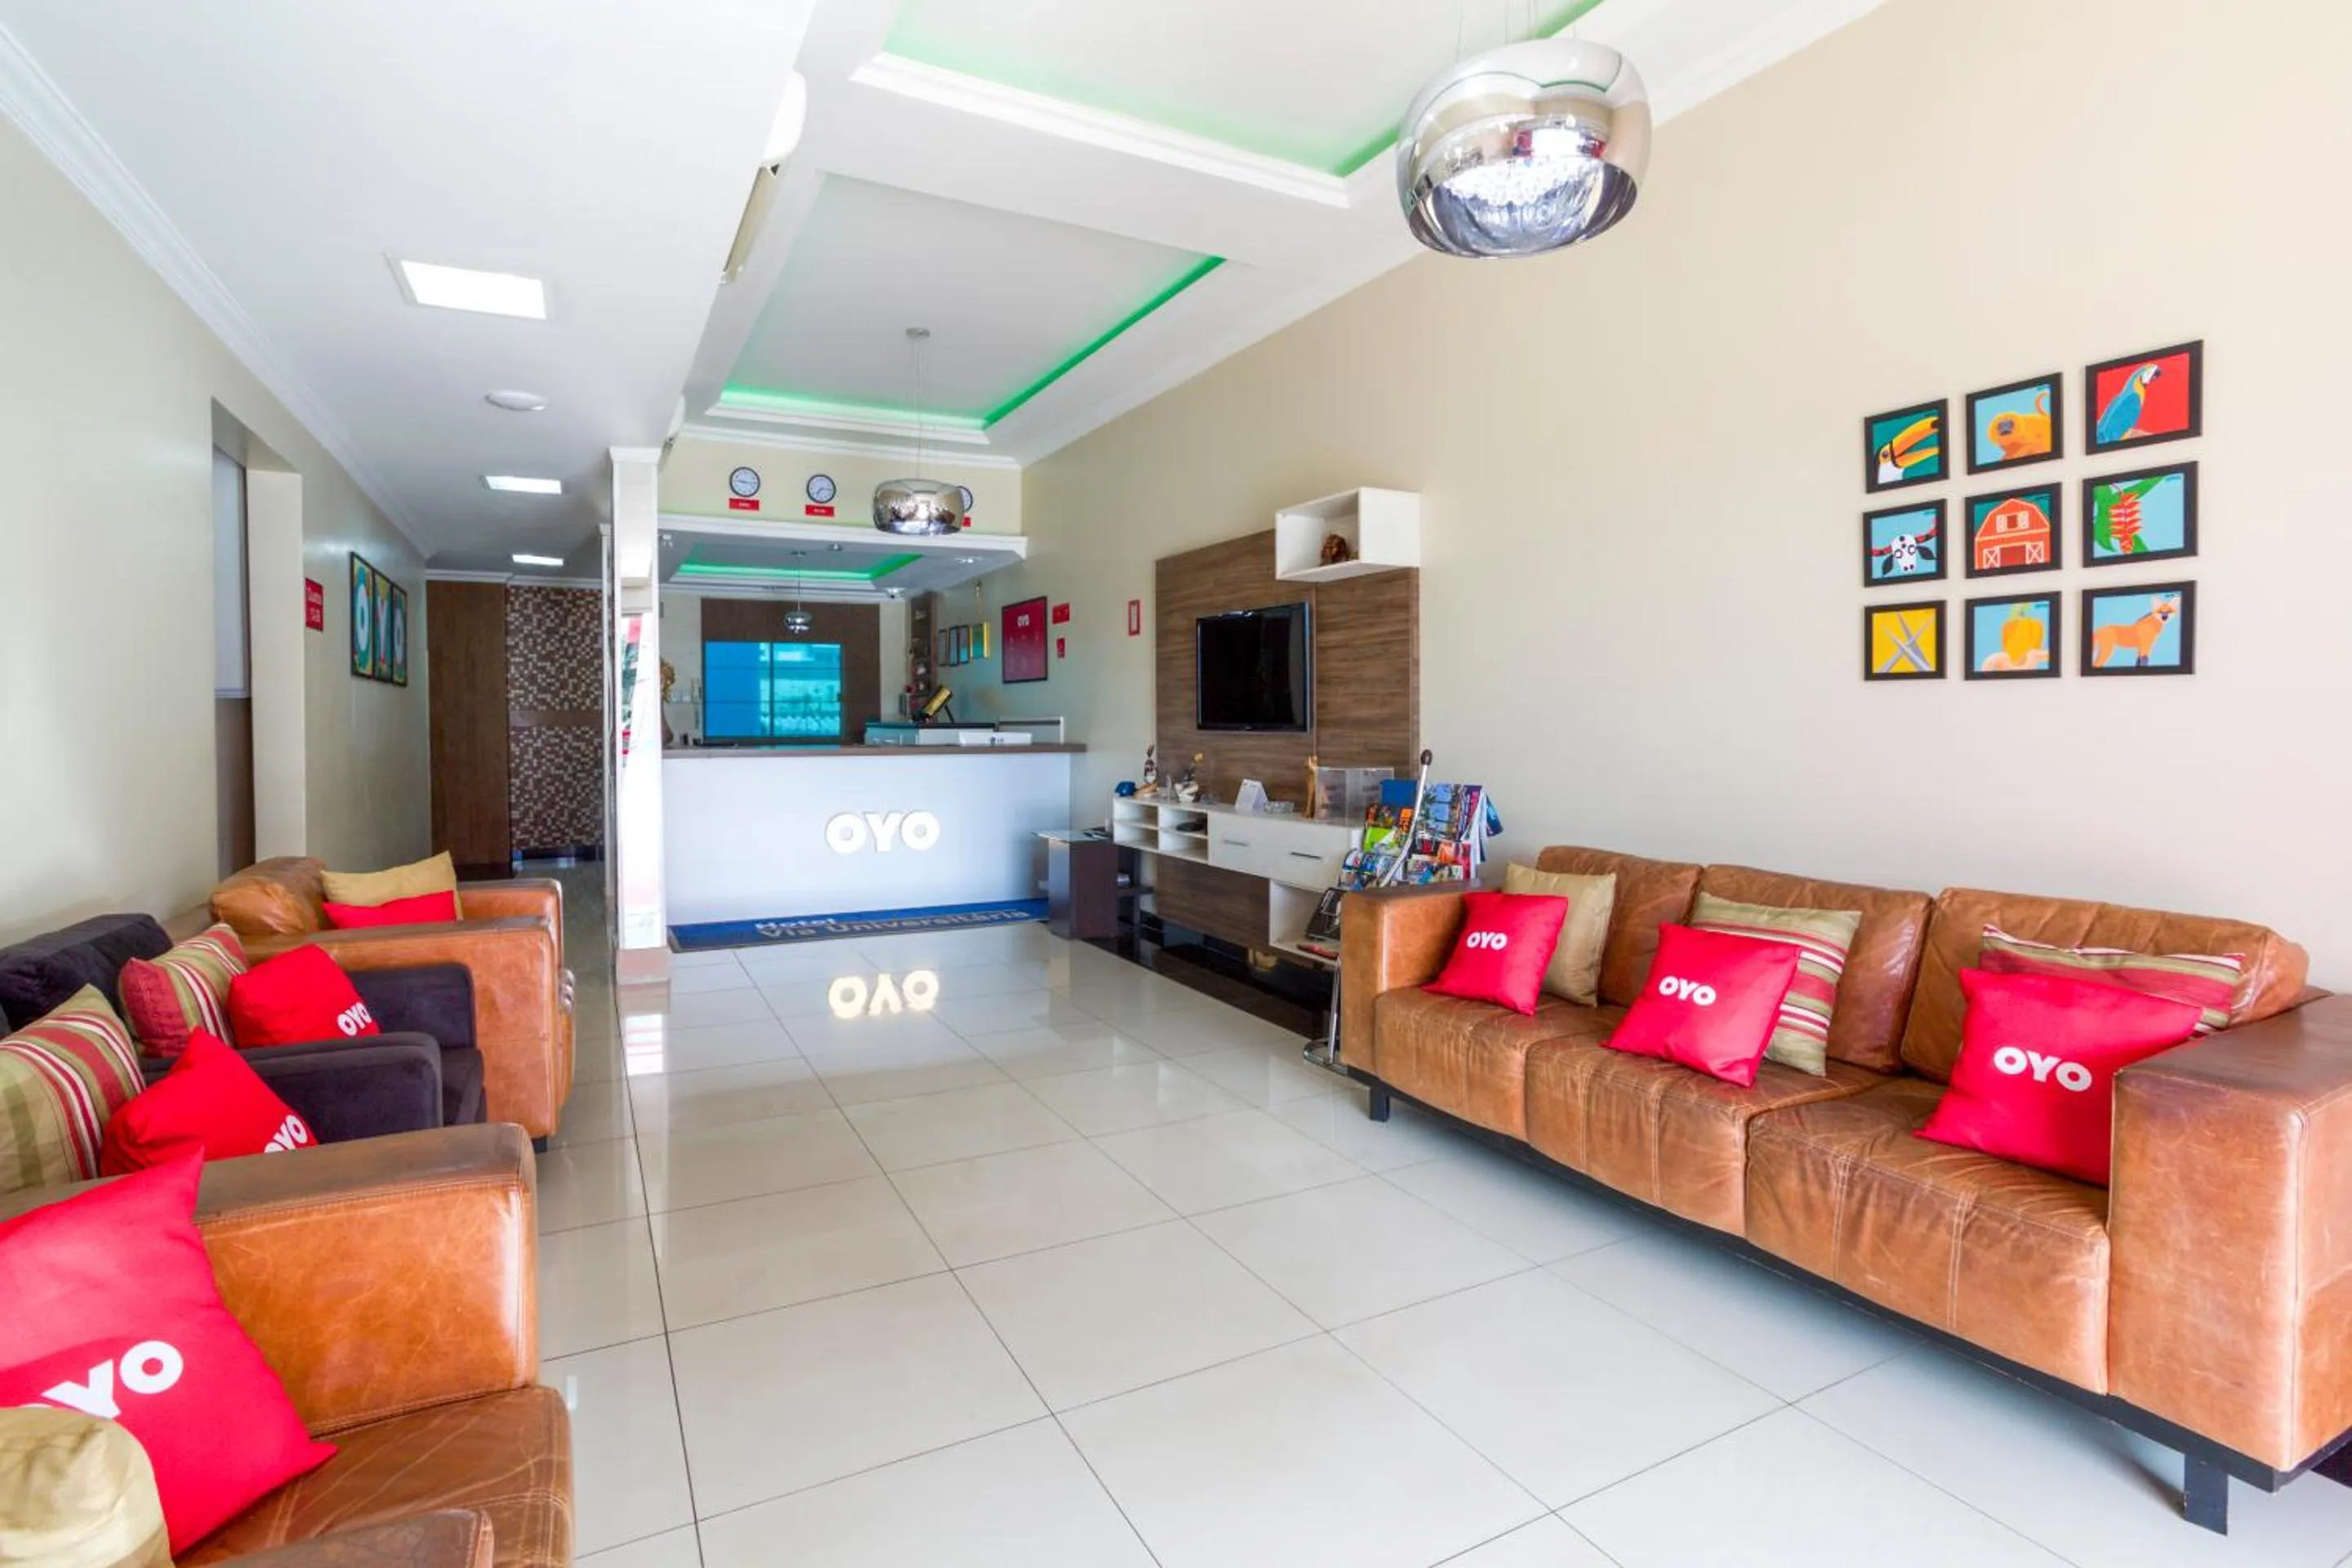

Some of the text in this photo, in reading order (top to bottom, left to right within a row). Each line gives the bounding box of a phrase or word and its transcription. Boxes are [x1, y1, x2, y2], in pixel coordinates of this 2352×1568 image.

[824, 809, 941, 854] OYO
[1467, 931, 1508, 951] OYO
[1659, 975, 1717, 1006] OYO
[337, 1002, 372, 1036] OYO
[1993, 1046, 2093, 1092] OYO
[18, 1340, 184, 1420] YO
